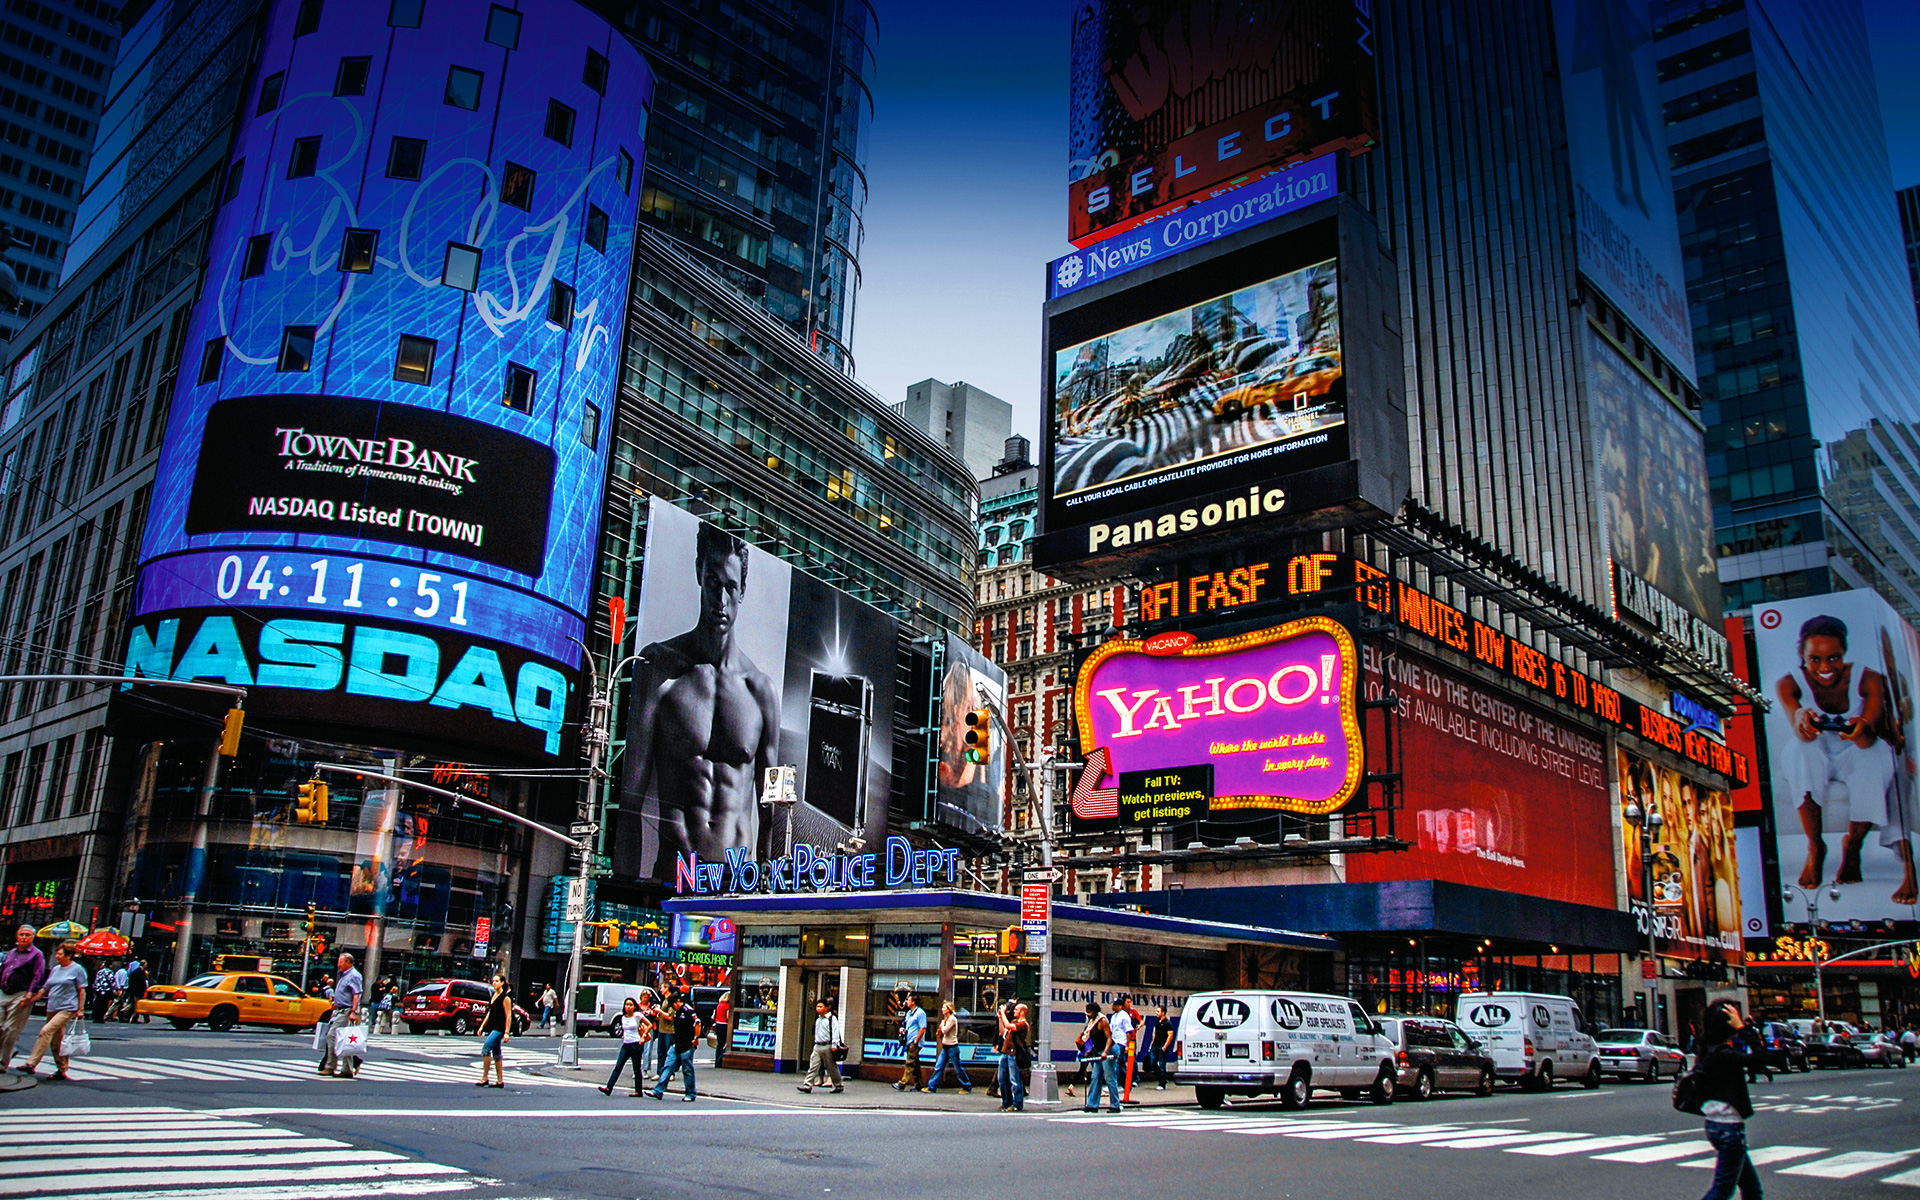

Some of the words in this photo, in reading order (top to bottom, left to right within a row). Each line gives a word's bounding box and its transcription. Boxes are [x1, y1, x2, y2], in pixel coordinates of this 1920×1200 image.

[1088, 91, 1339, 214] SELECT
[1087, 235, 1151, 278] News
[1163, 169, 1328, 247] Corporation
[285, 460, 294, 469] A
[296, 460, 343, 473] Tradition
[344, 464, 357, 477] of
[358, 466, 416, 484] Hometown
[1066, 497, 1083, 507] CALL
[1083, 491, 1102, 502] YOUR
[1102, 486, 1124, 497] LOCAL
[1124, 481, 1147, 493] CABLE
[1147, 477, 1158, 486] OR
[1159, 468, 1195, 484] SATELLITE
[1197, 458, 1234, 474] PROVIDER
[1234, 454, 1250, 465] FOR
[1250, 448, 1273, 461] MORE
[1274, 434, 1328, 454] INFORMATION
[249, 496, 333, 521] NASDAQ
[340, 503, 401, 528] Listed
[407, 510, 483, 547] [TOWN]
[1089, 486, 1286, 553] Panasonic
[1288, 554, 1338, 595] OF
[217, 555, 468, 626] 04:11:51
[1146, 636, 1189, 651] VACANCY
[121, 615, 568, 757] NASDAQ
[1096, 654, 1336, 739] YAHOO!
[1474, 620, 1505, 670] DOW
[1511, 639, 1547, 690] RISES
[1552, 661, 1567, 698] 16
[1570, 670, 1587, 708] TO
[1684, 732, 1708, 766] NEWS
[1710, 740, 1731, 776] FROM
[1733, 752, 1749, 784] THE
[1424, 669, 1441, 698] TO
[1444, 678, 1469, 710] THE
[1472, 691, 1516, 729] CENTER
[1519, 711, 1533, 734] OF
[1536, 717, 1556, 745] THE
[1557, 726, 1603, 764] UNIVERSE
[1209, 742, 1240, 755] Where
[1241, 740, 1258, 752] the
[1259, 735, 1290, 749] world
[1292, 731, 1325, 746] checks
[1415, 699, 1478, 744] AVAILABLE
[1481, 723, 1538, 766] INCLUDING
[1540, 749, 1575, 779] STREET
[1578, 762, 1605, 791] LEVEL
[1263, 759, 1275, 773] in
[1275, 759, 1304, 772] every
[1145, 776, 1162, 788] Fall
[1164, 775, 1181, 786] TV:
[1122, 793, 1152, 805] Watch
[1154, 790, 1205, 805] previews,
[1134, 808, 1150, 821] get
[1152, 806, 1191, 818] listings
[676, 851, 724, 893] NEW
[793, 843, 876, 890] POLICE
[886, 836, 959, 886] DEPT
[1476, 847, 1486, 859] The
[572, 885, 582, 897] NO
[548, 875, 562, 953] MARKETSITE
[568, 904, 583, 915] TURNS
[751, 934, 788, 947] POLICE
[884, 934, 929, 948] POLICE
[1051, 988, 1097, 1004] ELCOME
[1202, 998, 1244, 1026] ALL
[1276, 999, 1300, 1027] ALL
[1475, 1004, 1506, 1025] ALL
[747, 1032, 776, 1046] NYPD
